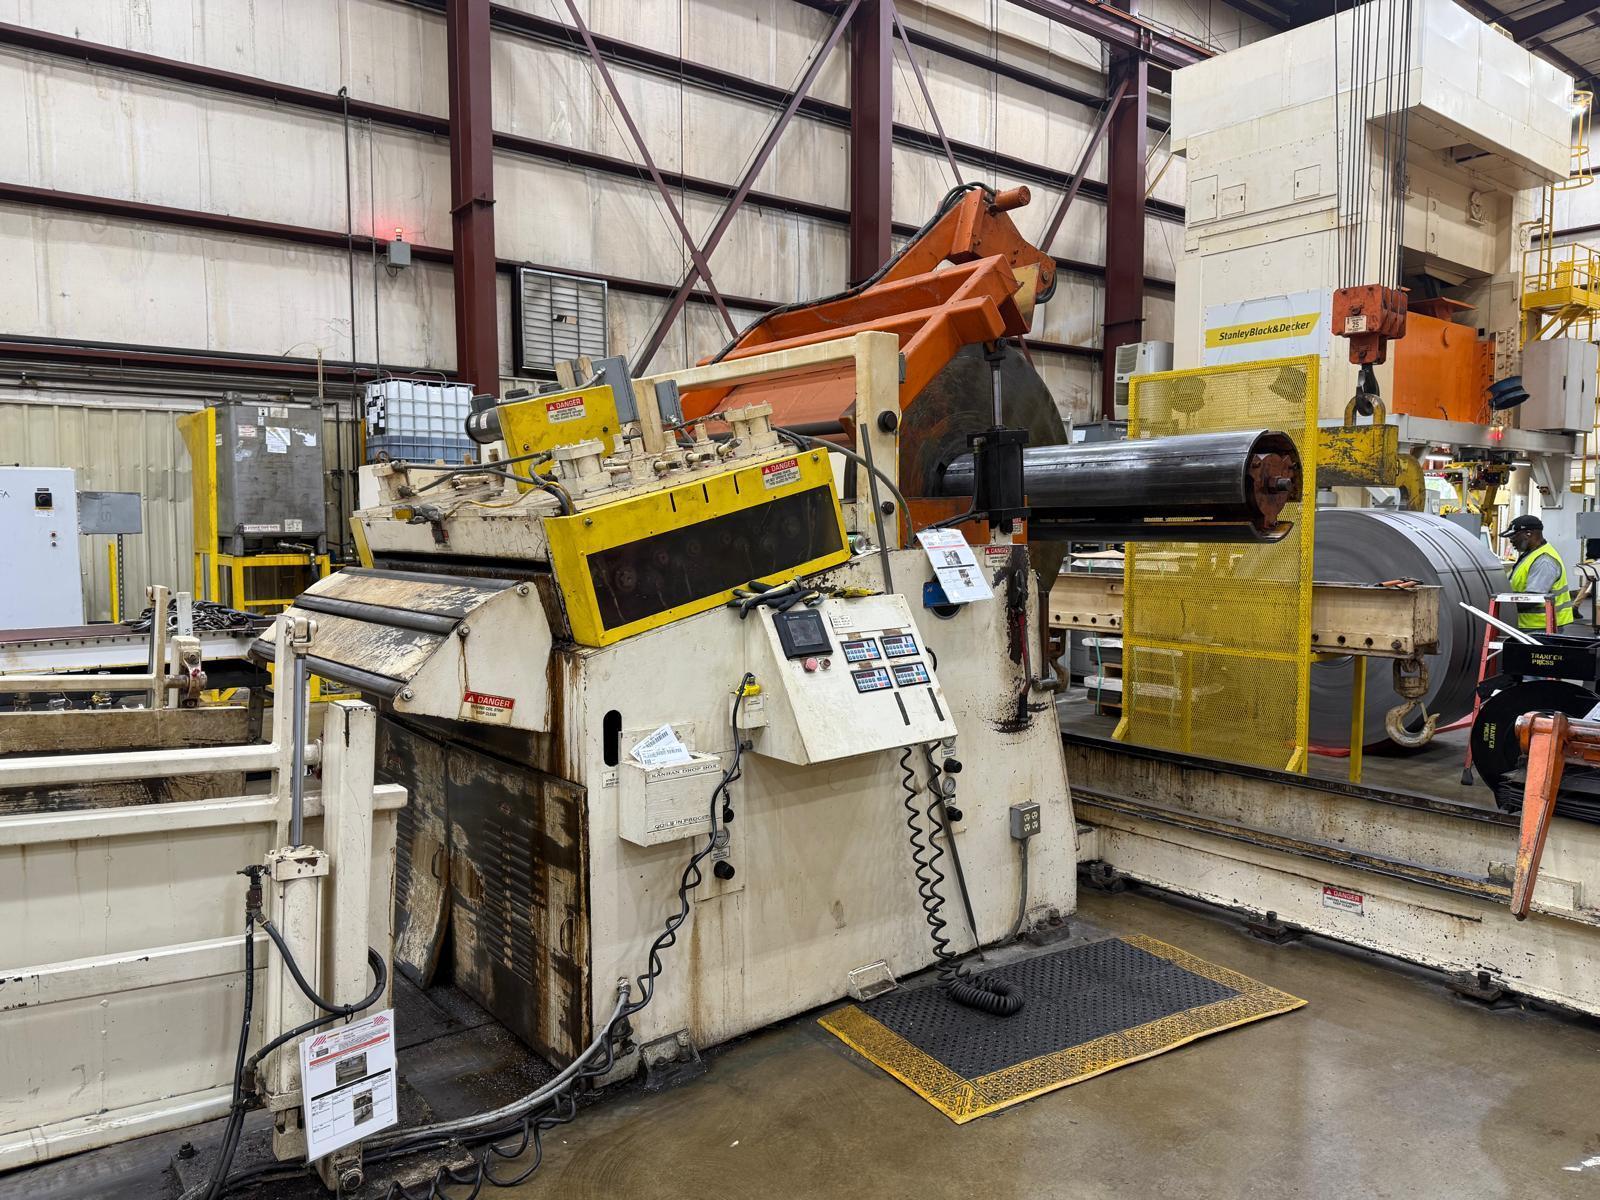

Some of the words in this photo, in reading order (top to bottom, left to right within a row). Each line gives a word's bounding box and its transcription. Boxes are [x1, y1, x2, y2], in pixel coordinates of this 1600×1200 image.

[1219, 320, 1311, 341] StanleyBlack&Decker
[556, 398, 581, 410] DANGER
[771, 459, 796, 472] DANGER
[477, 695, 510, 708] DANGER
[1333, 890, 1360, 902] DANGER
